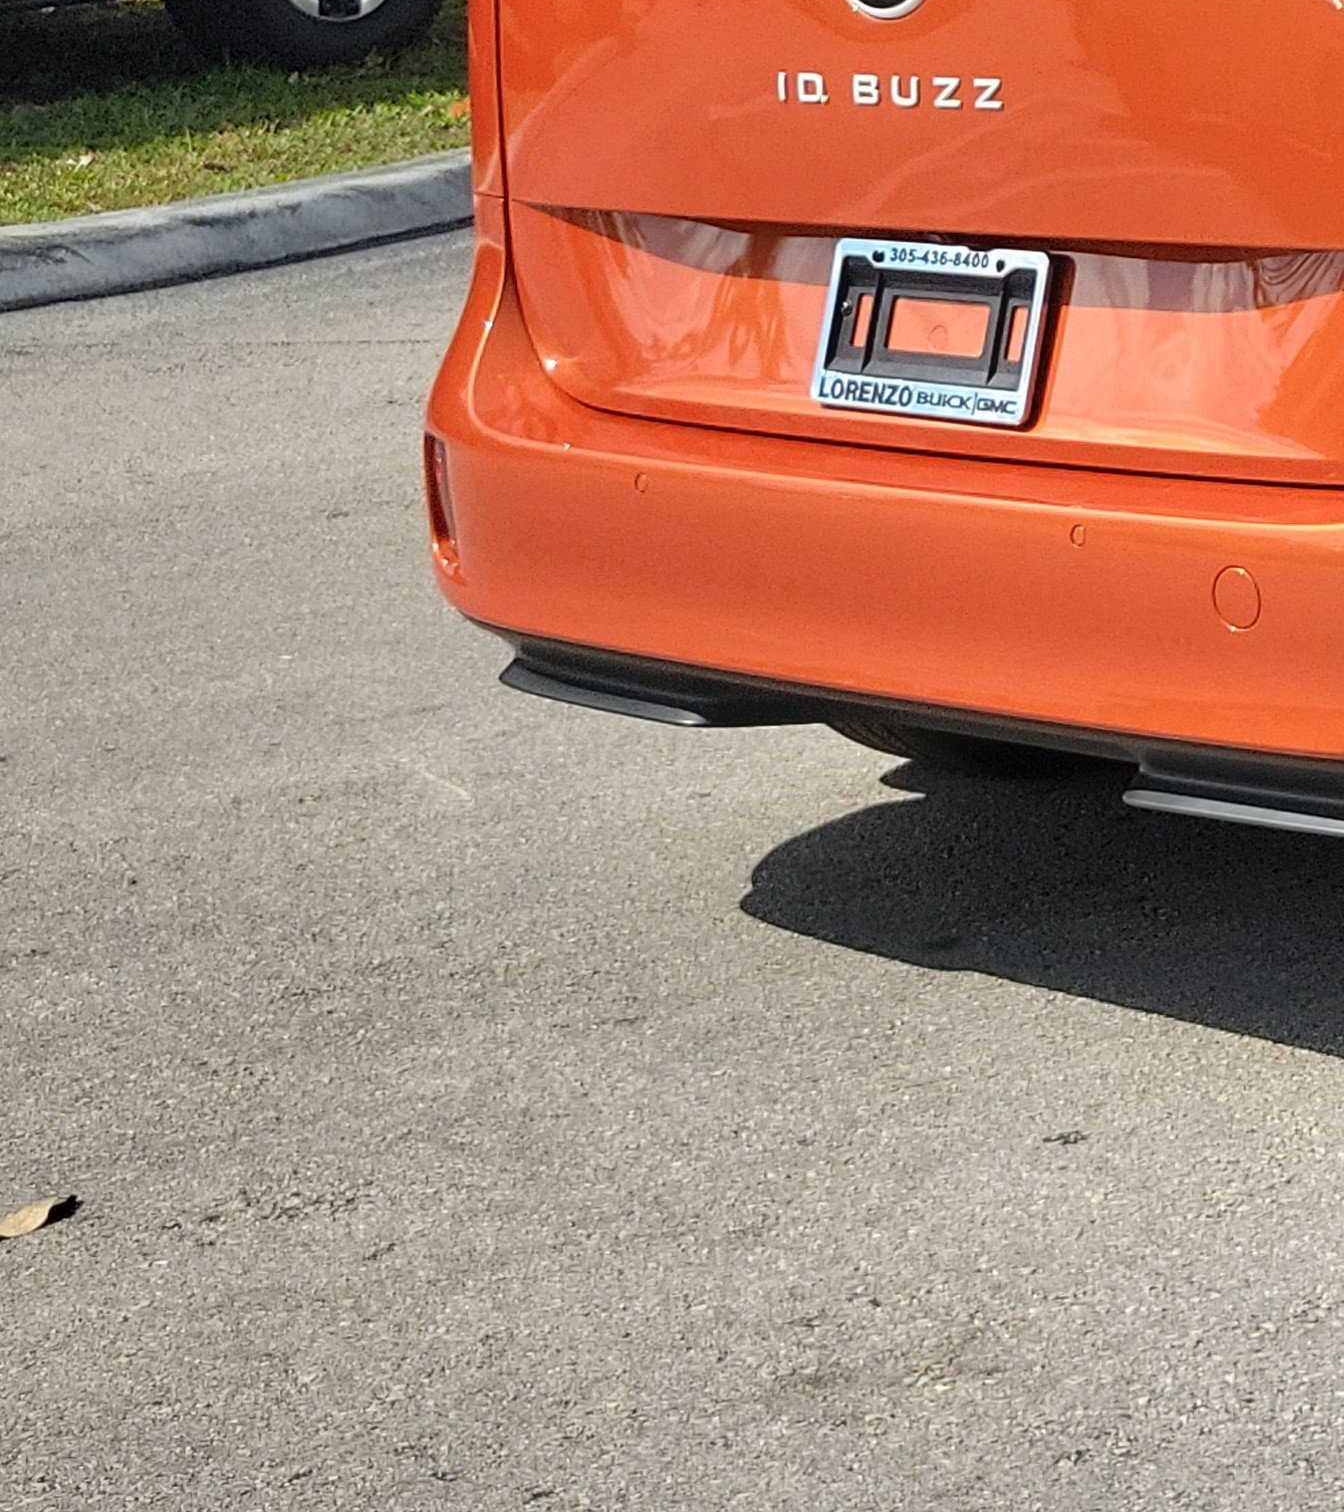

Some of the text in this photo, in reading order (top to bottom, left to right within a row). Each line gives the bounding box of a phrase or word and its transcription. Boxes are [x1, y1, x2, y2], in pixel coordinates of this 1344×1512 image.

[852, 73, 1004, 111] BUZZ
[889, 247, 991, 270] 305-436-8400
[818, 376, 914, 408] LORENZO
[915, 390, 973, 411] BUICK
